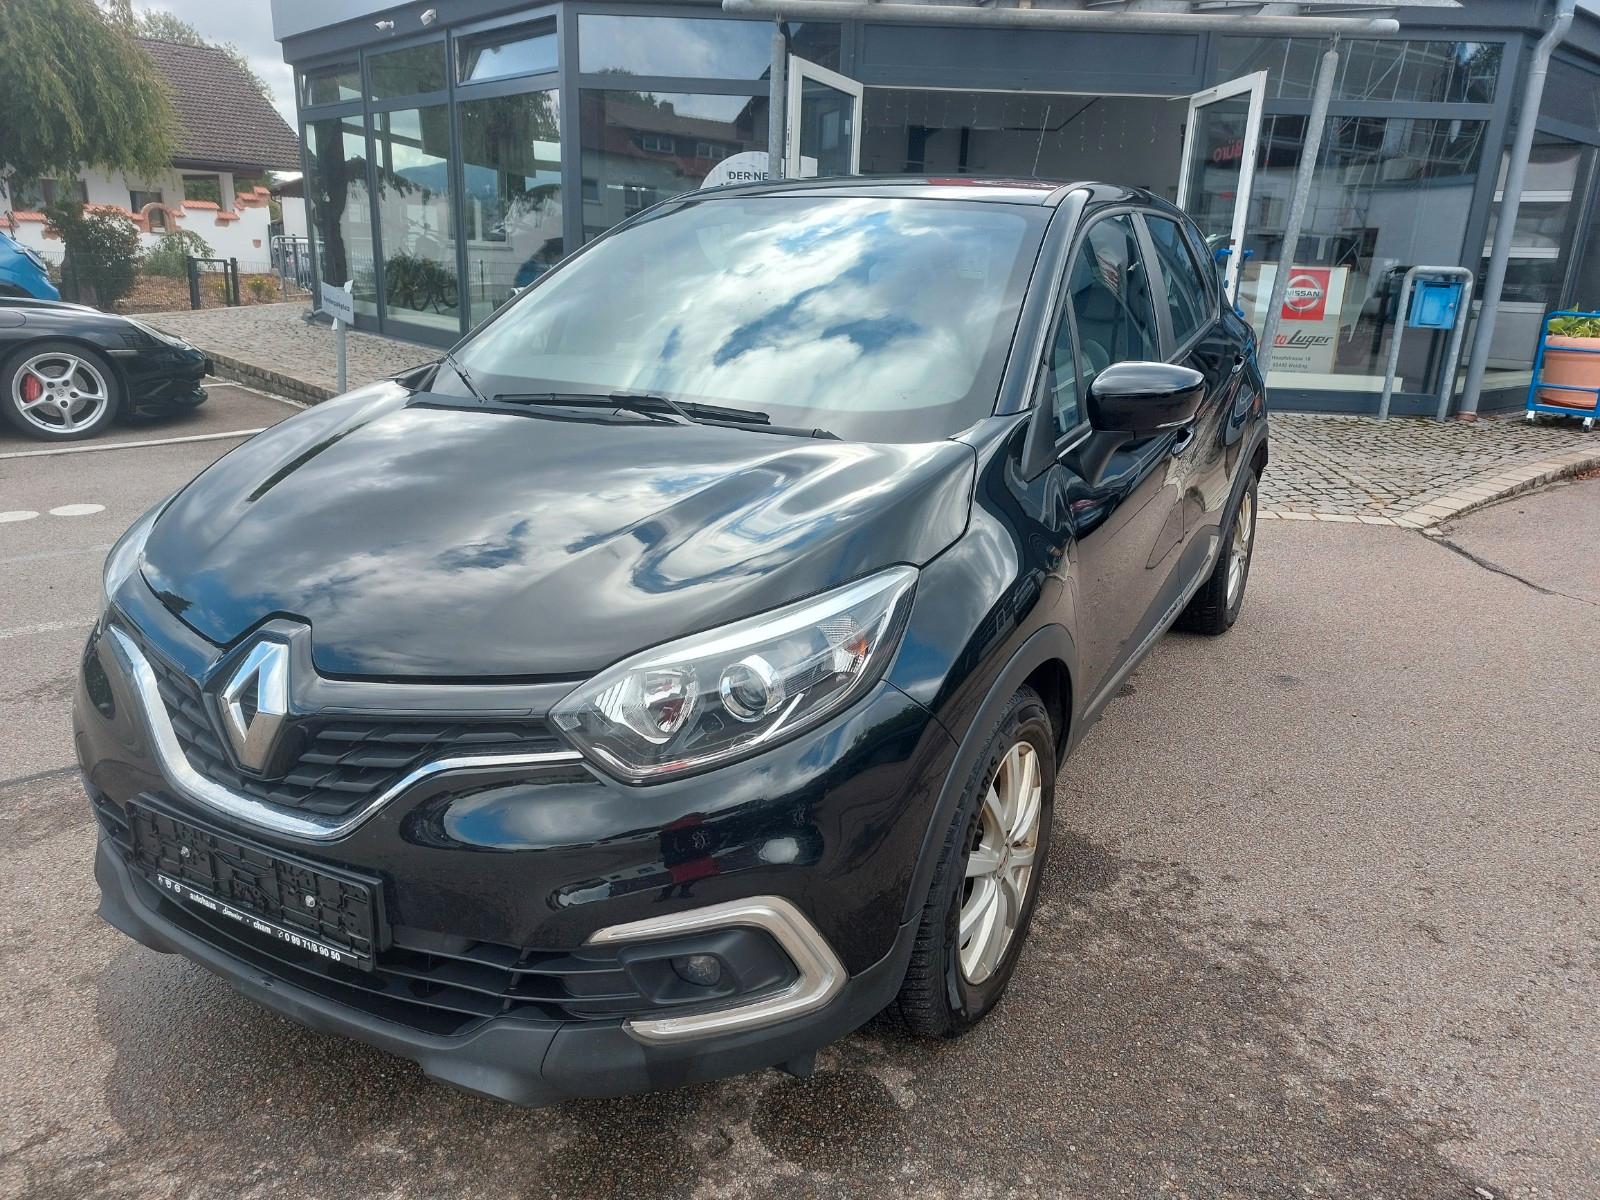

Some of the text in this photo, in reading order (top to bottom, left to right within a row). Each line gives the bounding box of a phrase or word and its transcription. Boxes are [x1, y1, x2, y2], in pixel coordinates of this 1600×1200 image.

[728, 171, 751, 180] DER
[1287, 289, 1320, 297] NISSAN
[1287, 329, 1334, 349] Luger
[253, 920, 272, 935] cham
